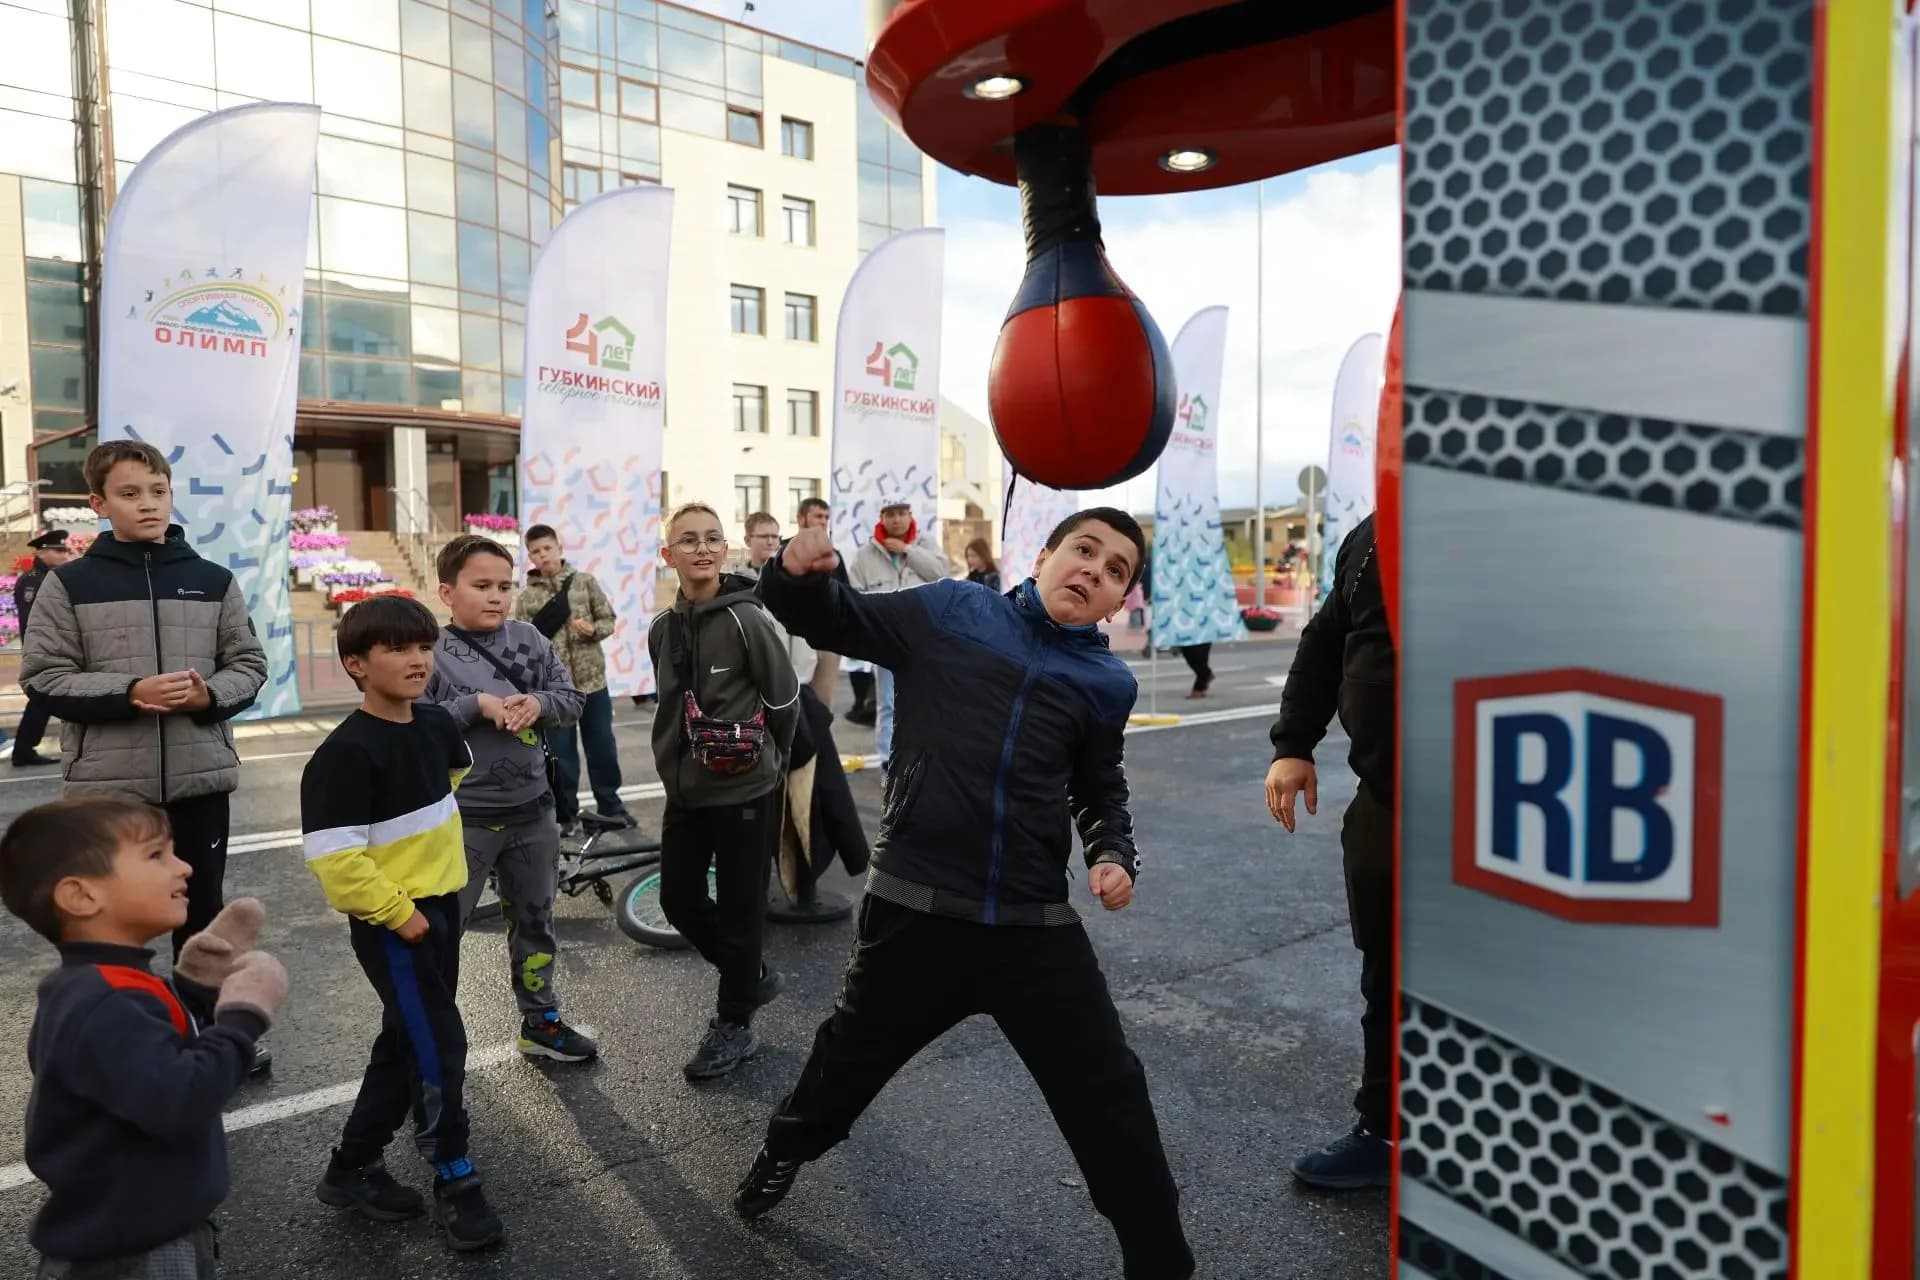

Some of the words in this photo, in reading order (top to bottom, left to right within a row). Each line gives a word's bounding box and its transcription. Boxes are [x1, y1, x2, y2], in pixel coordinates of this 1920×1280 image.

[154, 327, 268, 358] ОЛИМП
[538, 366, 660, 400] ГУБКИНСКИЙ
[844, 390, 935, 415] ГУБКИНСКИЙ
[1491, 711, 1675, 884] RB
